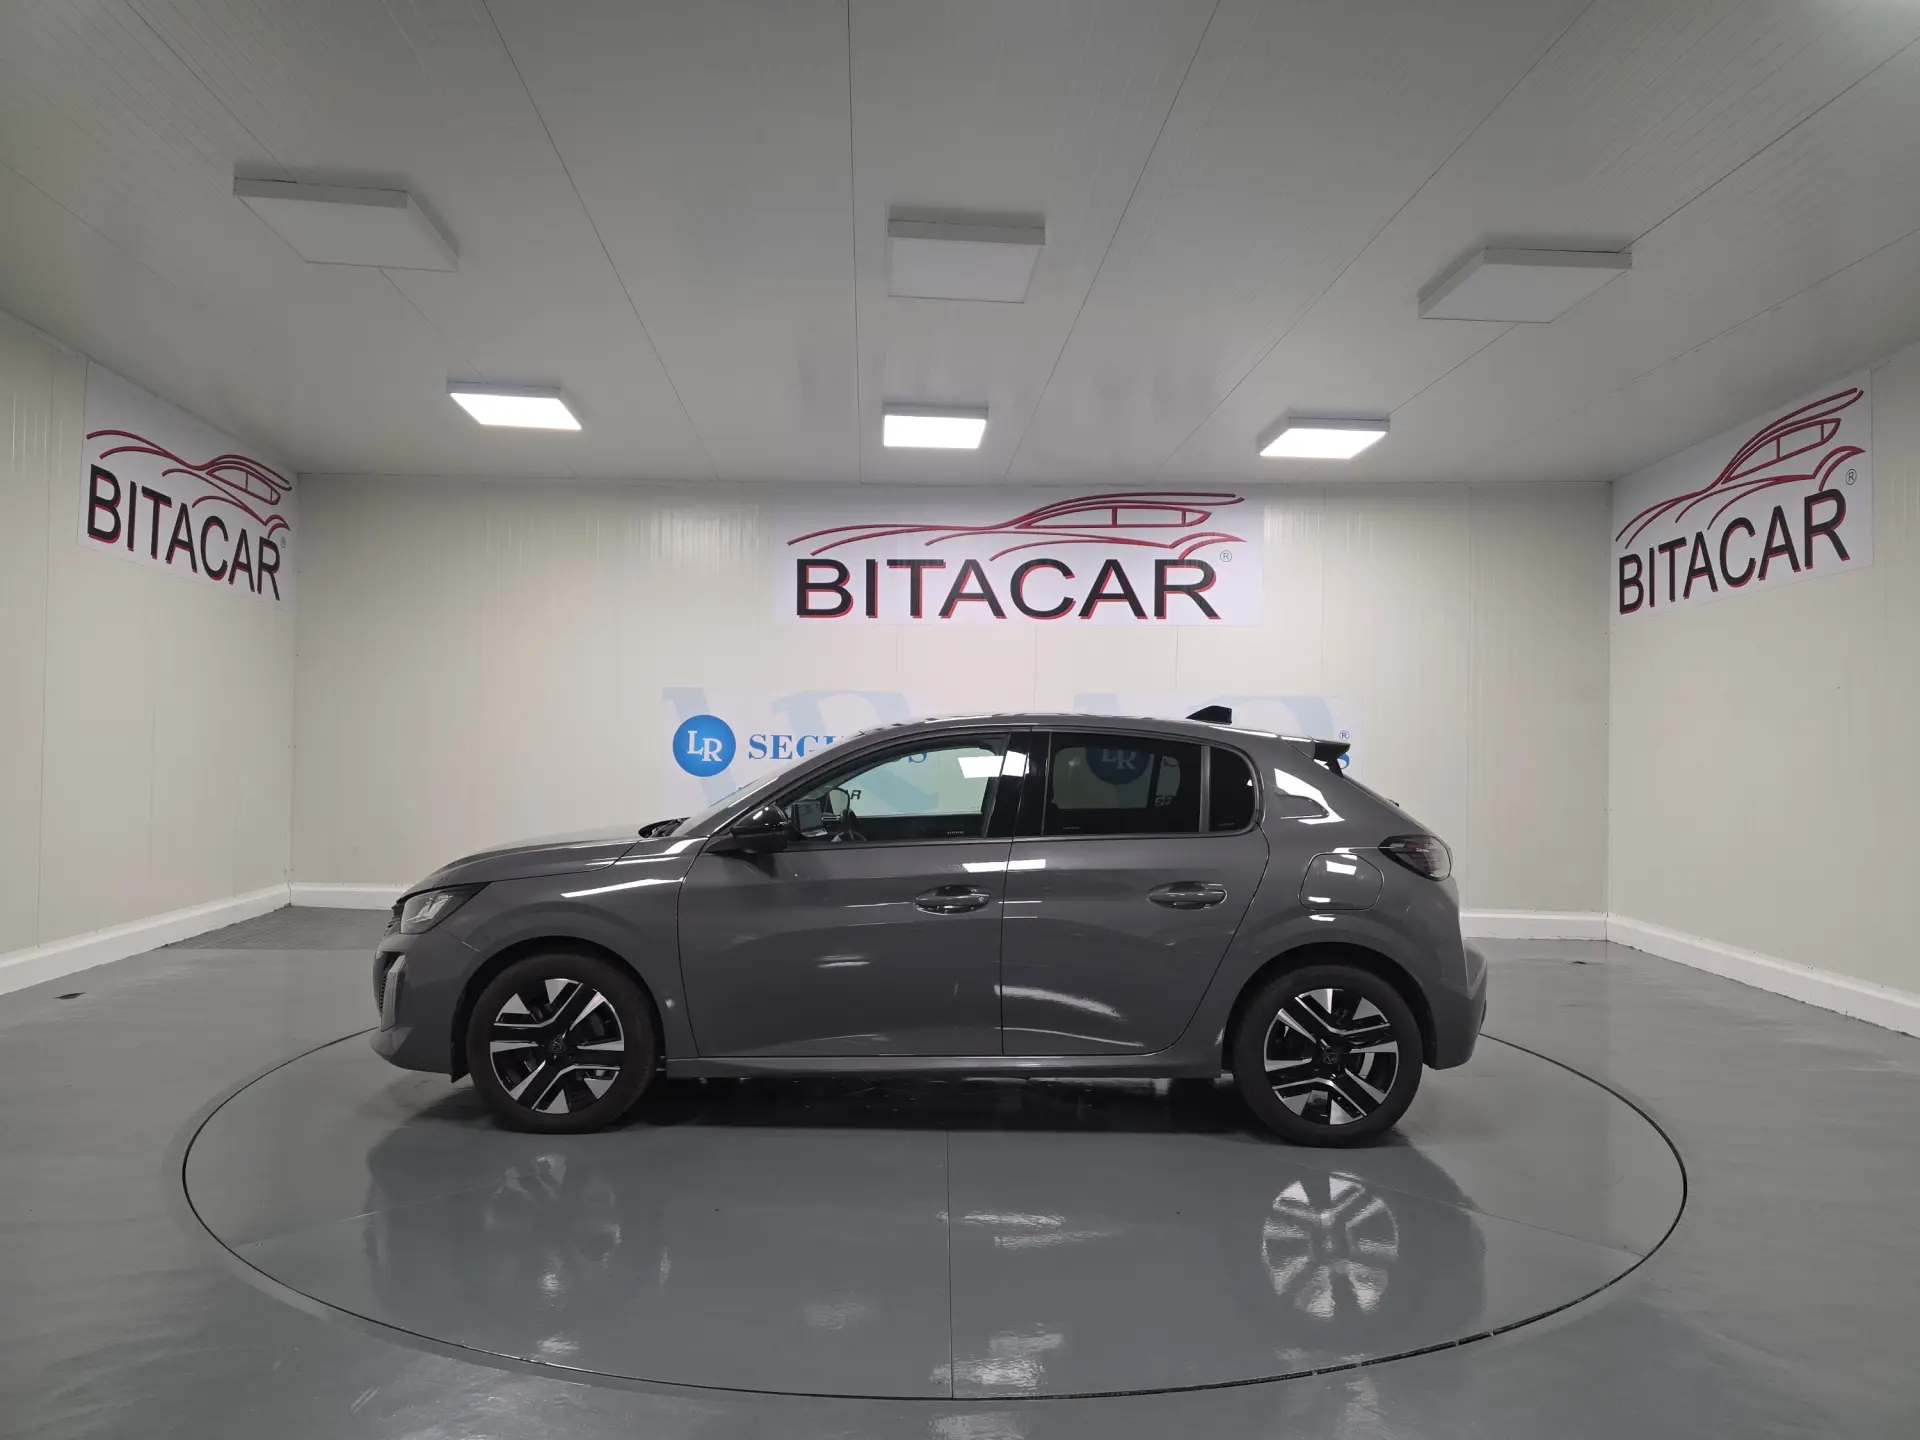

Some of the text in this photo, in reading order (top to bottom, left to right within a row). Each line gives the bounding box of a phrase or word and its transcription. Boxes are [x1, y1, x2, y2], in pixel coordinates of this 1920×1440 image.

[87, 464, 281, 601] BITACAR
[1618, 488, 1851, 615] BITACAR
[796, 557, 1222, 620] BITACAR
[686, 730, 723, 762] LR
